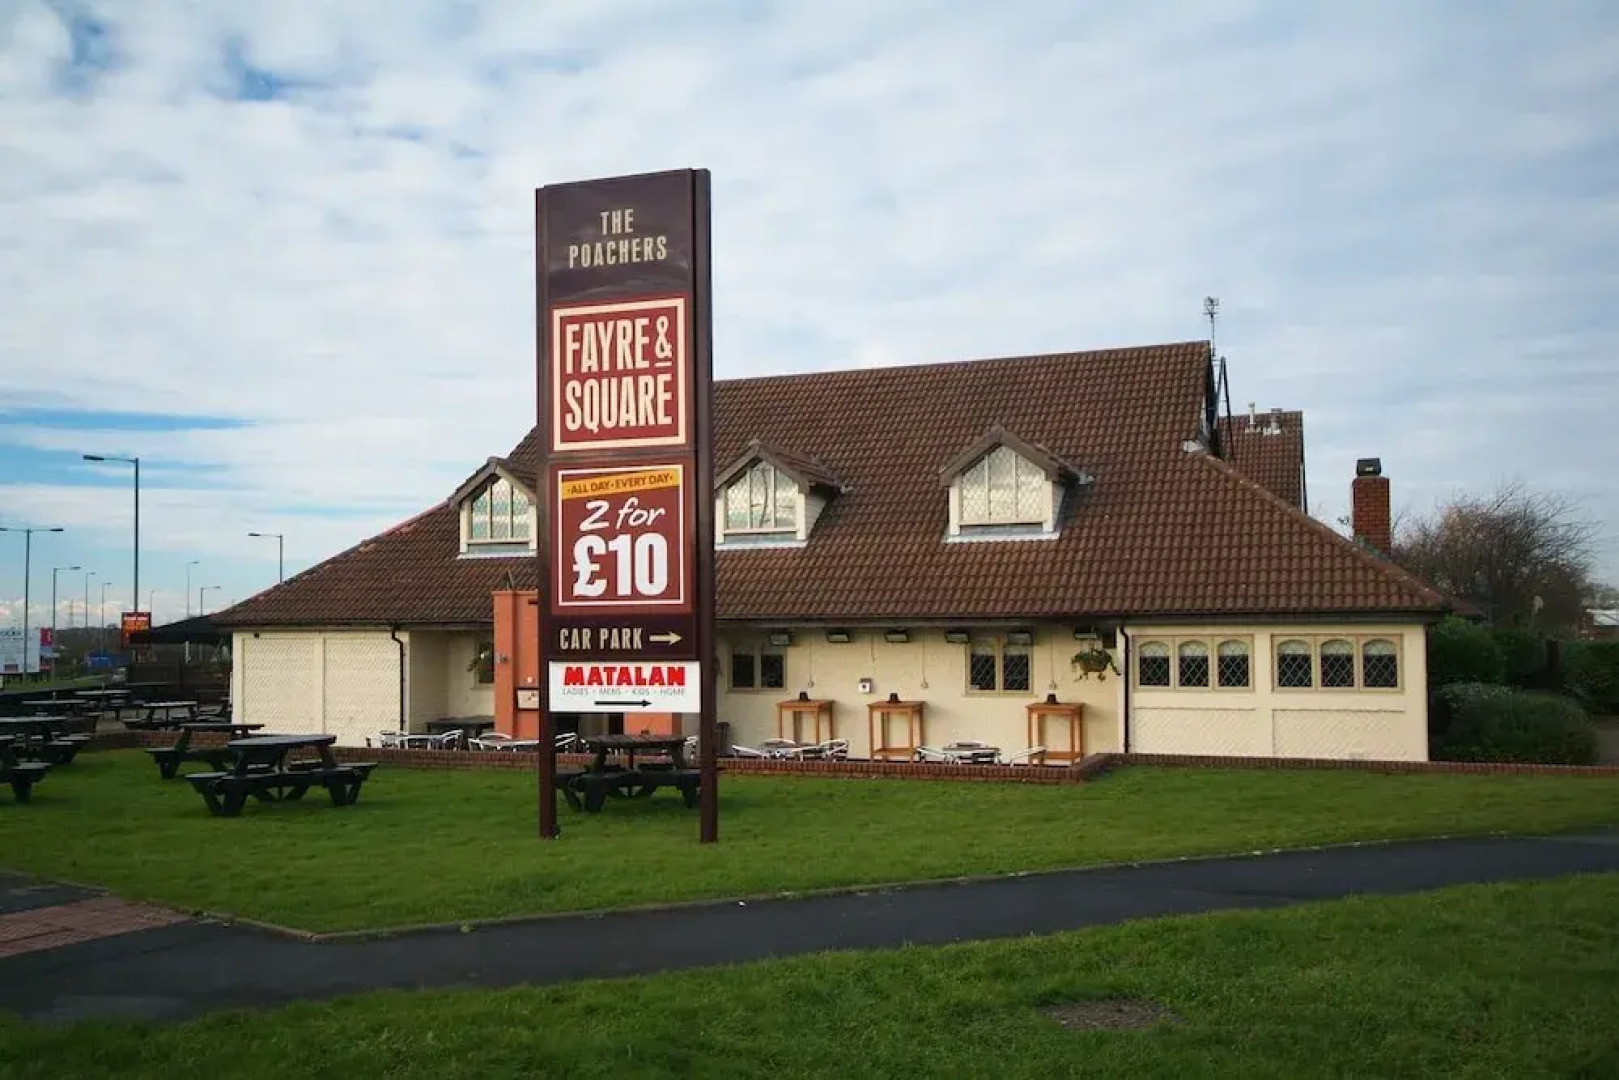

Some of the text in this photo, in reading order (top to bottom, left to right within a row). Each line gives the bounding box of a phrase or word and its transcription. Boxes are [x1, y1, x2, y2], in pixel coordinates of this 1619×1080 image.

[600, 208, 634, 235] THE
[569, 235, 667, 269] POACHERS
[565, 315, 673, 374] FAYRE &
[565, 373, 673, 434] SQUARE
[579, 496, 666, 531] 2 for
[572, 532, 669, 597] £10
[559, 627, 643, 650] CAR PARK
[564, 666, 686, 686] MATALAN
